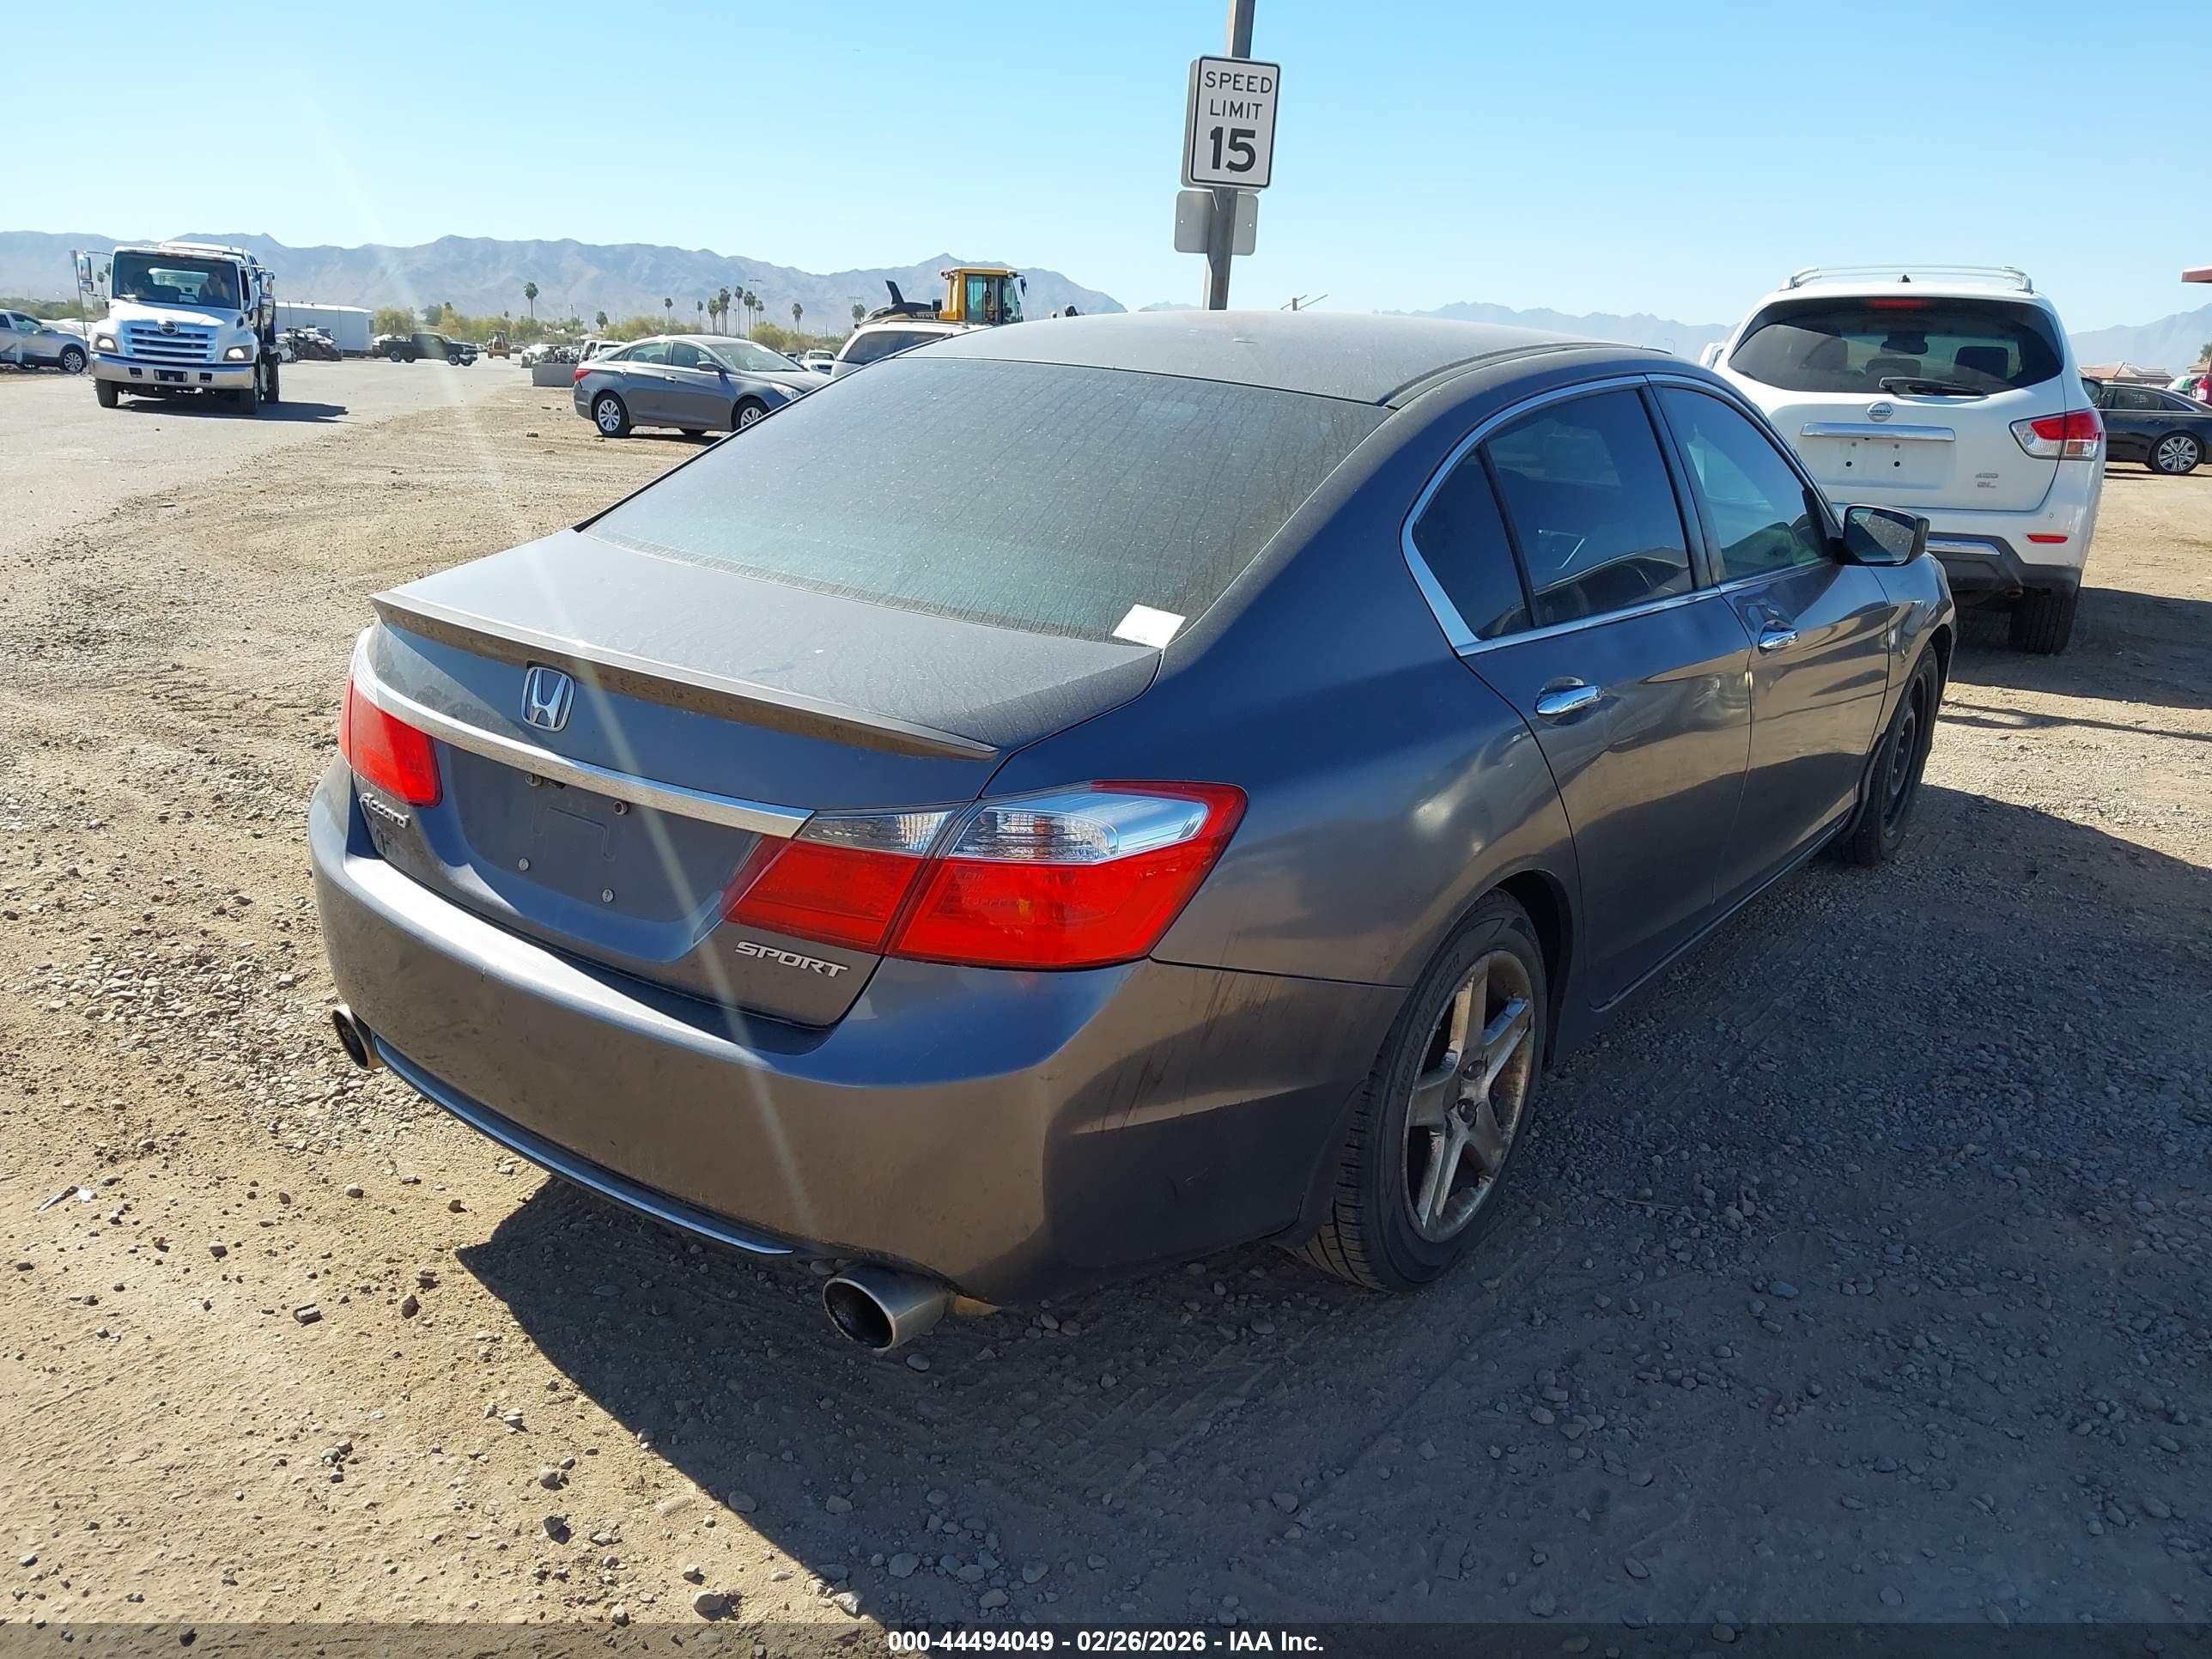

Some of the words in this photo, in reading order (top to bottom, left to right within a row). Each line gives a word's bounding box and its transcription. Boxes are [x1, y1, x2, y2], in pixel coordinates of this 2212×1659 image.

[1204, 70, 1273, 94] SPEED
[1209, 99, 1263, 120] LIMIT
[1209, 126, 1256, 173] 15
[734, 941, 849, 978] SPORT
